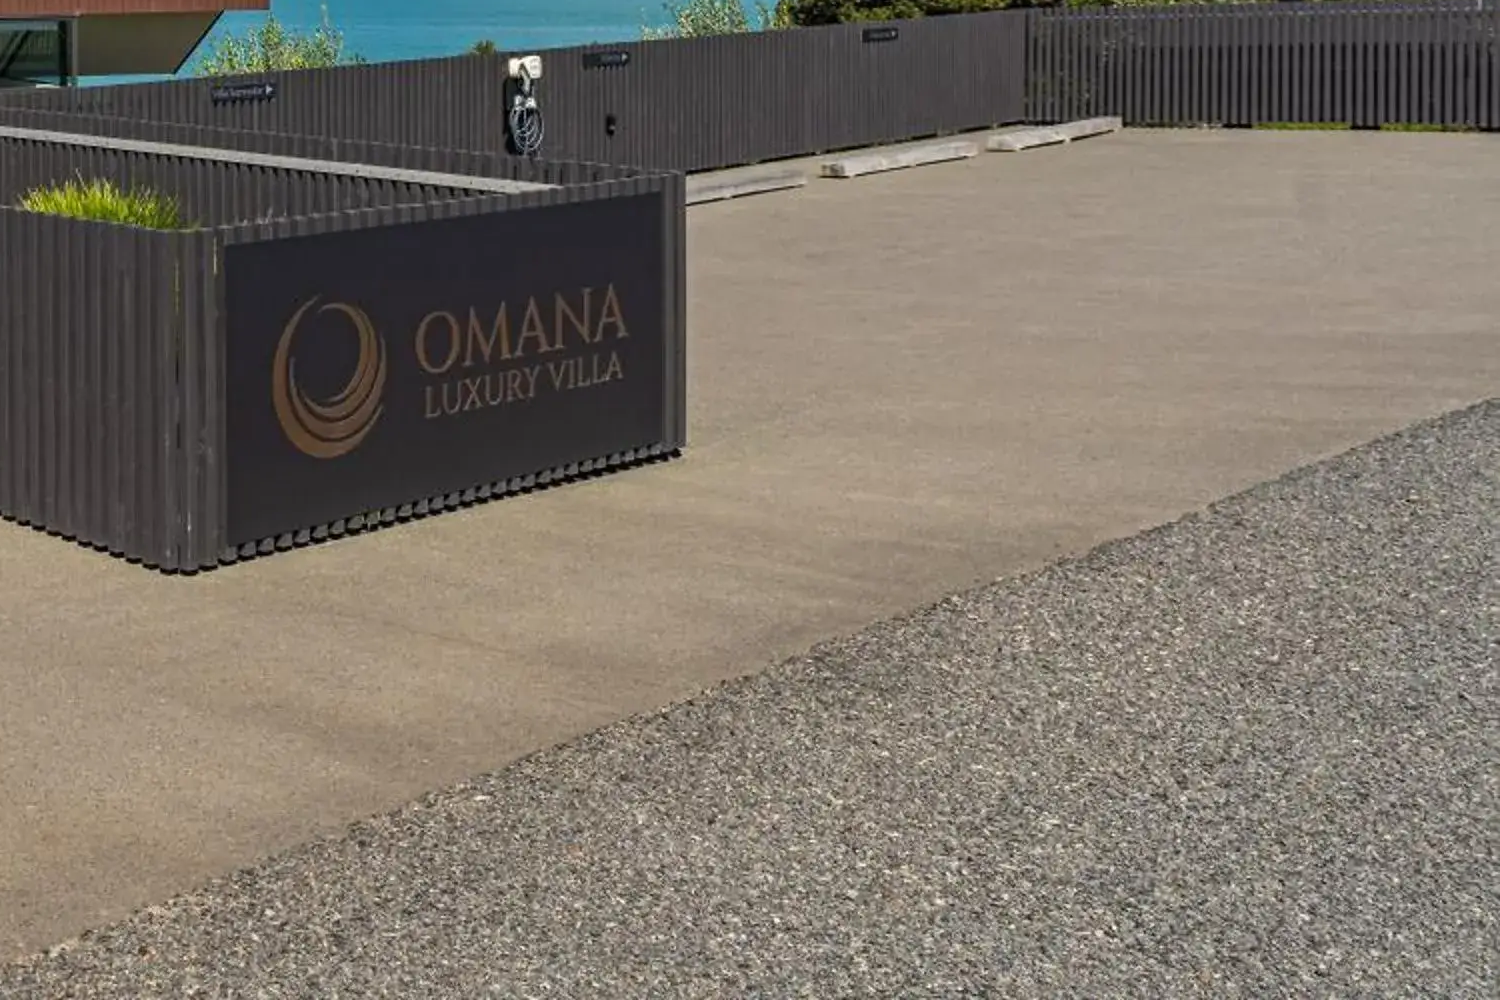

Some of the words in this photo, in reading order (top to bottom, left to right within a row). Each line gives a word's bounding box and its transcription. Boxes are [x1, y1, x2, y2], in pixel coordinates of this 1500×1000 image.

[415, 282, 629, 373] OMANA
[424, 363, 542, 418] LUXURY
[548, 351, 624, 390] VILLA
